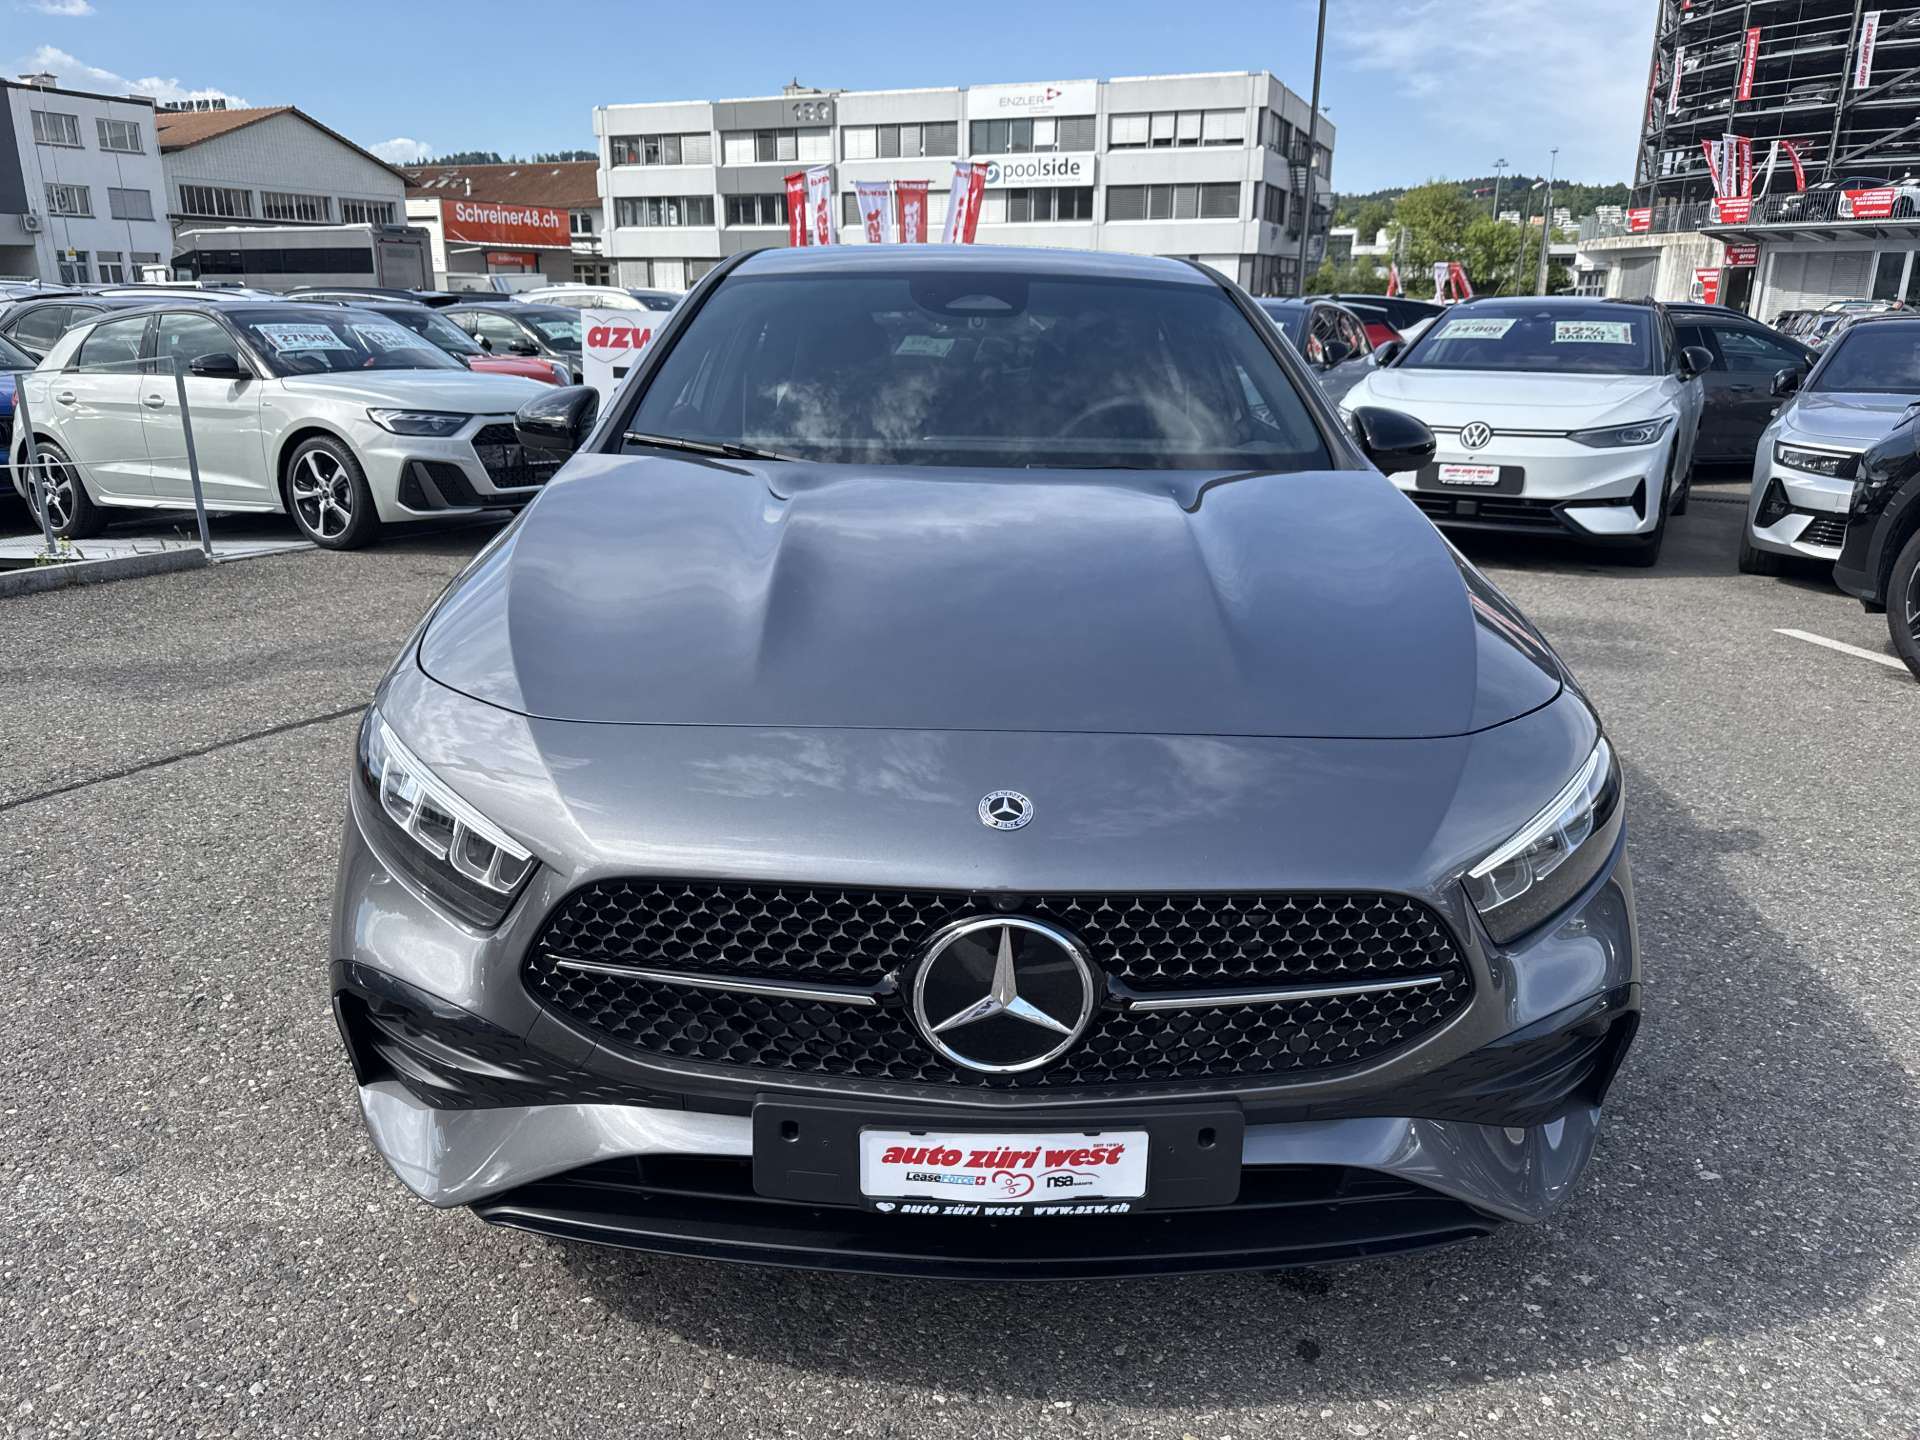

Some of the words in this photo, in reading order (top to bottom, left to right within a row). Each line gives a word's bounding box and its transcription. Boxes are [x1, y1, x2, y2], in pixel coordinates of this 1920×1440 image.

[999, 95, 1046, 107] ENZLER
[1003, 157, 1081, 184] poolside
[455, 202, 560, 229] Schreiner48.ch
[881, 1145, 963, 1167] auto
[963, 1146, 1042, 1169] züri
[1045, 1144, 1126, 1168] west
[906, 1172, 976, 1186] LeaseForce
[1046, 1175, 1074, 1188] nsa
[900, 1204, 939, 1214] auto
[942, 1203, 981, 1216] züri
[984, 1205, 1024, 1216] west
[1033, 1203, 1131, 1216] www.azw.ch
